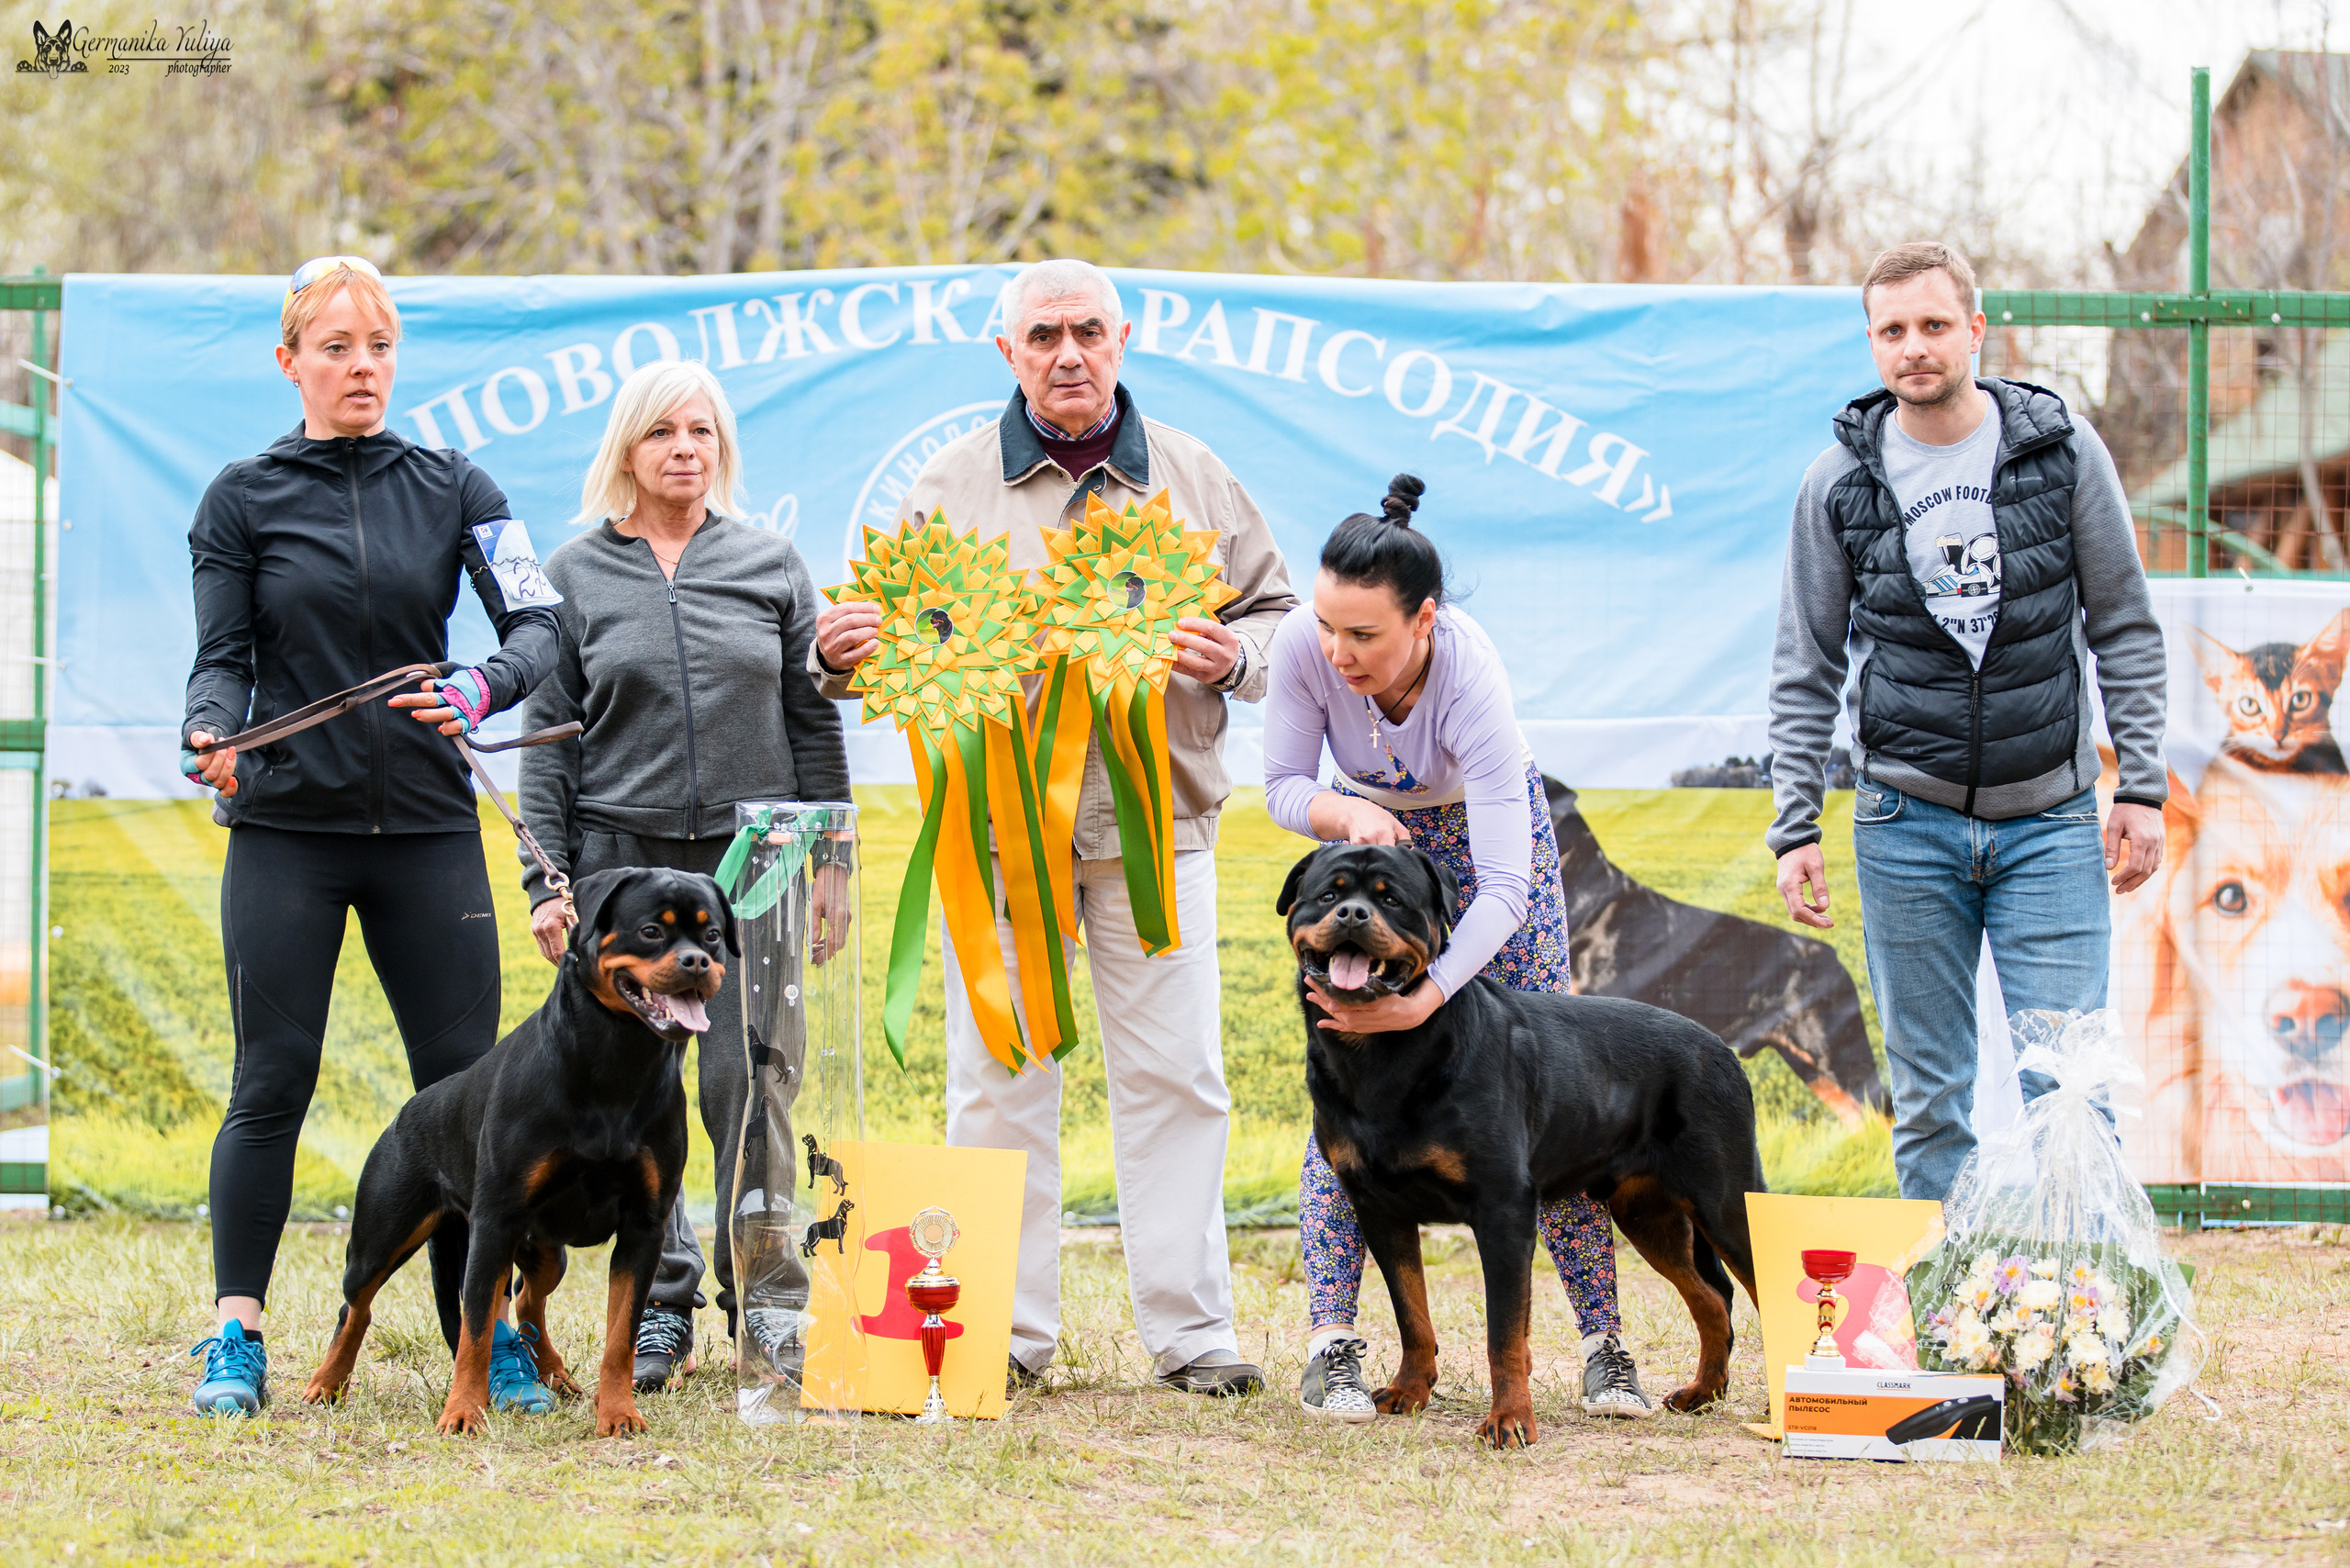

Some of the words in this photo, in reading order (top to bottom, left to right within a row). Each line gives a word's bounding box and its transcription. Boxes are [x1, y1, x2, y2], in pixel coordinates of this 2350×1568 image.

[1131, 286, 1674, 524] РАПСОДИЯ»
[1904, 487, 1953, 526] MOSCOW
[1788, 1396, 1868, 1406] АВТОМОБИЛЬНЫЙ
[1788, 1405, 1830, 1413] ПЫЛЕСОС
